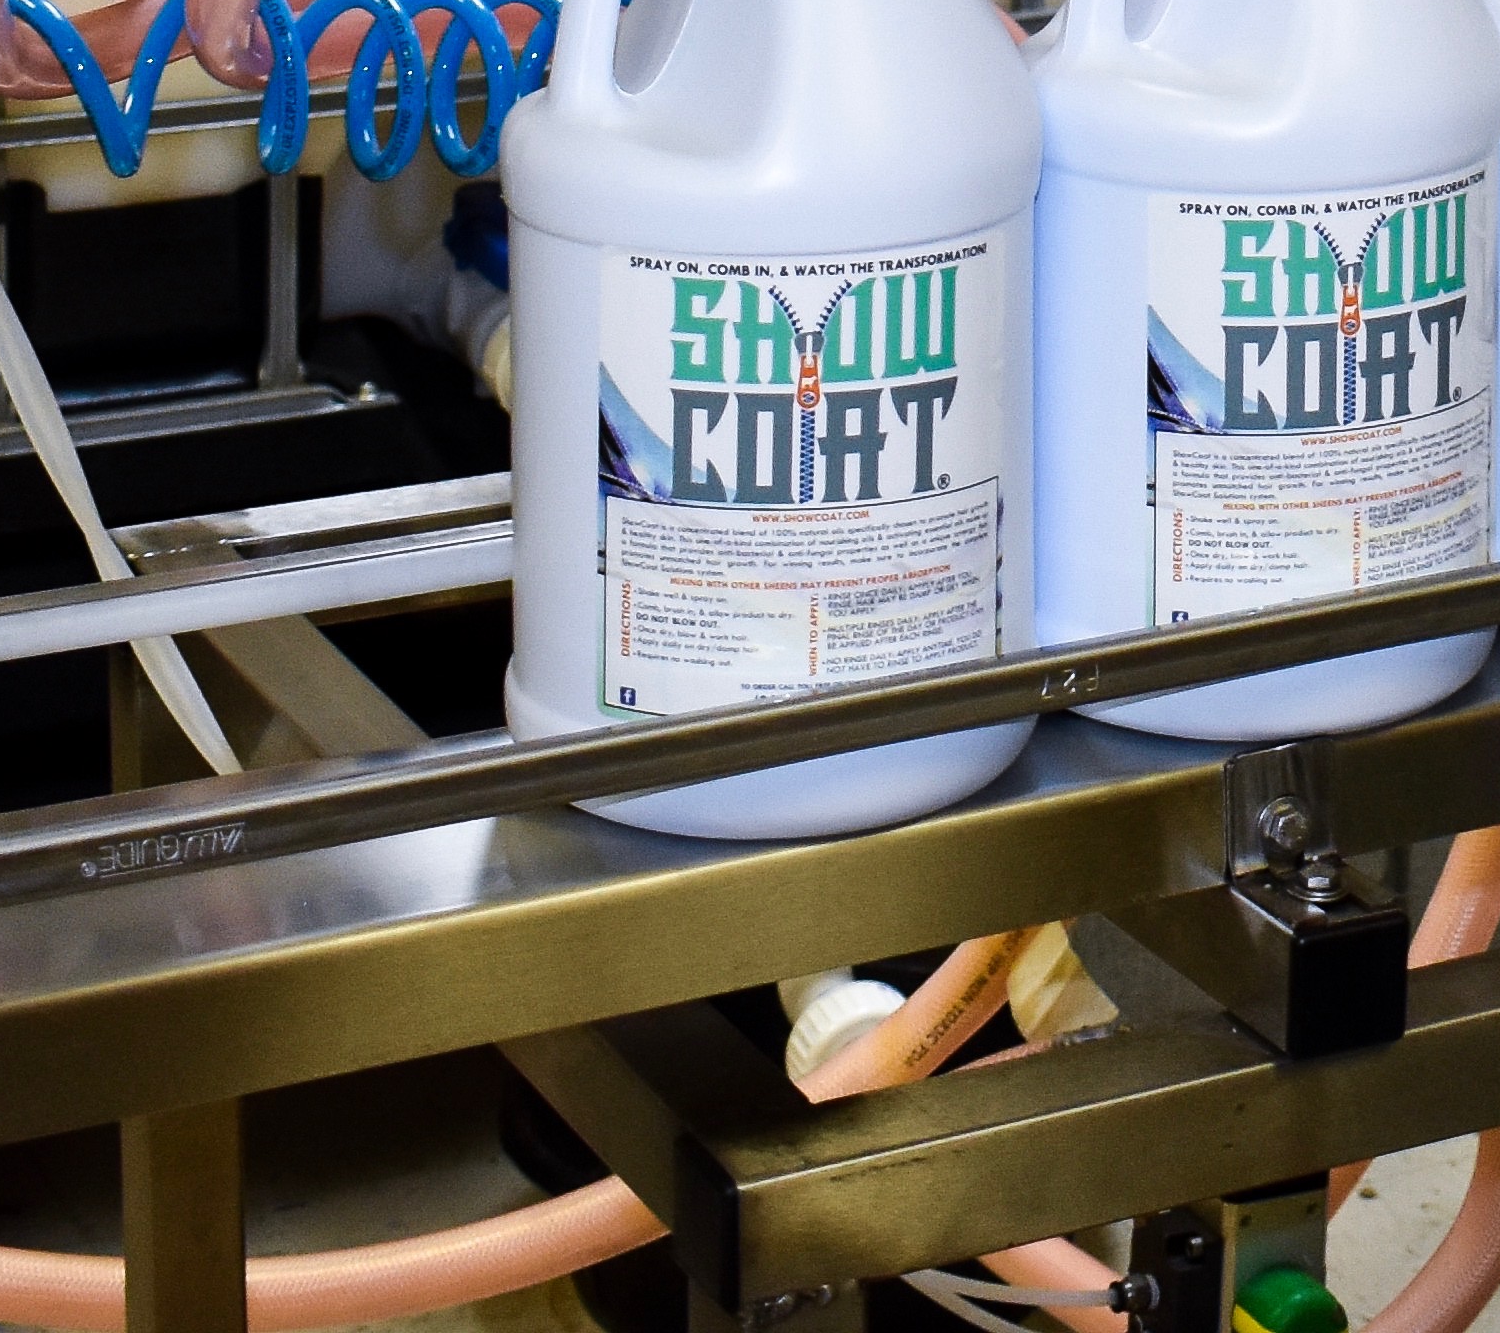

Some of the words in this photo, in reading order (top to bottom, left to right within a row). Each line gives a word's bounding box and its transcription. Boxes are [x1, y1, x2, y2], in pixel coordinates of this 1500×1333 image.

[1179, 203, 1222, 217] SPRAY
[1226, 204, 1252, 218] ON,
[1257, 204, 1297, 216] COMB
[1301, 203, 1319, 216] IN,
[1324, 203, 1332, 214] &
[1337, 197, 1381, 212] WATCH
[1384, 194, 1405, 207] THE
[630, 256, 672, 271] SPRAY
[677, 262, 703, 275] ON,
[708, 264, 750, 276] COMB
[755, 265, 775, 278] IN,
[780, 266, 789, 277] &
[794, 264, 845, 276] WATCH
[850, 262, 874, 274] THE
[879, 243, 987, 271] TRANSFORMATION!
[1221, 193, 1467, 318] SHOW
[670, 265, 959, 384] SHOW
[1221, 296, 1467, 431] COAT
[669, 376, 958, 506] COAT
[1301, 427, 1402, 446] WWW.SHOWCOAT.COM
[1259, 503, 1279, 511] WITH
[1282, 501, 1309, 510] OTHER
[1365, 489, 1398, 502] PREVENT
[752, 509, 870, 524] WWW.SHOWCOAT.COM
[1173, 508, 1183, 582] DIRECTIONS:
[1204, 540, 1222, 548] NOT
[706, 579, 728, 588] WITH
[731, 580, 760, 590] OTHER
[800, 580, 822, 590] MAY
[825, 578, 863, 589] PREVENT
[621, 579, 631, 657] DIRECTIONS:
[636, 613, 648, 621] DO
[651, 615, 669, 623] NOT
[672, 618, 696, 626] BLOW
[809, 629, 818, 643] TO
